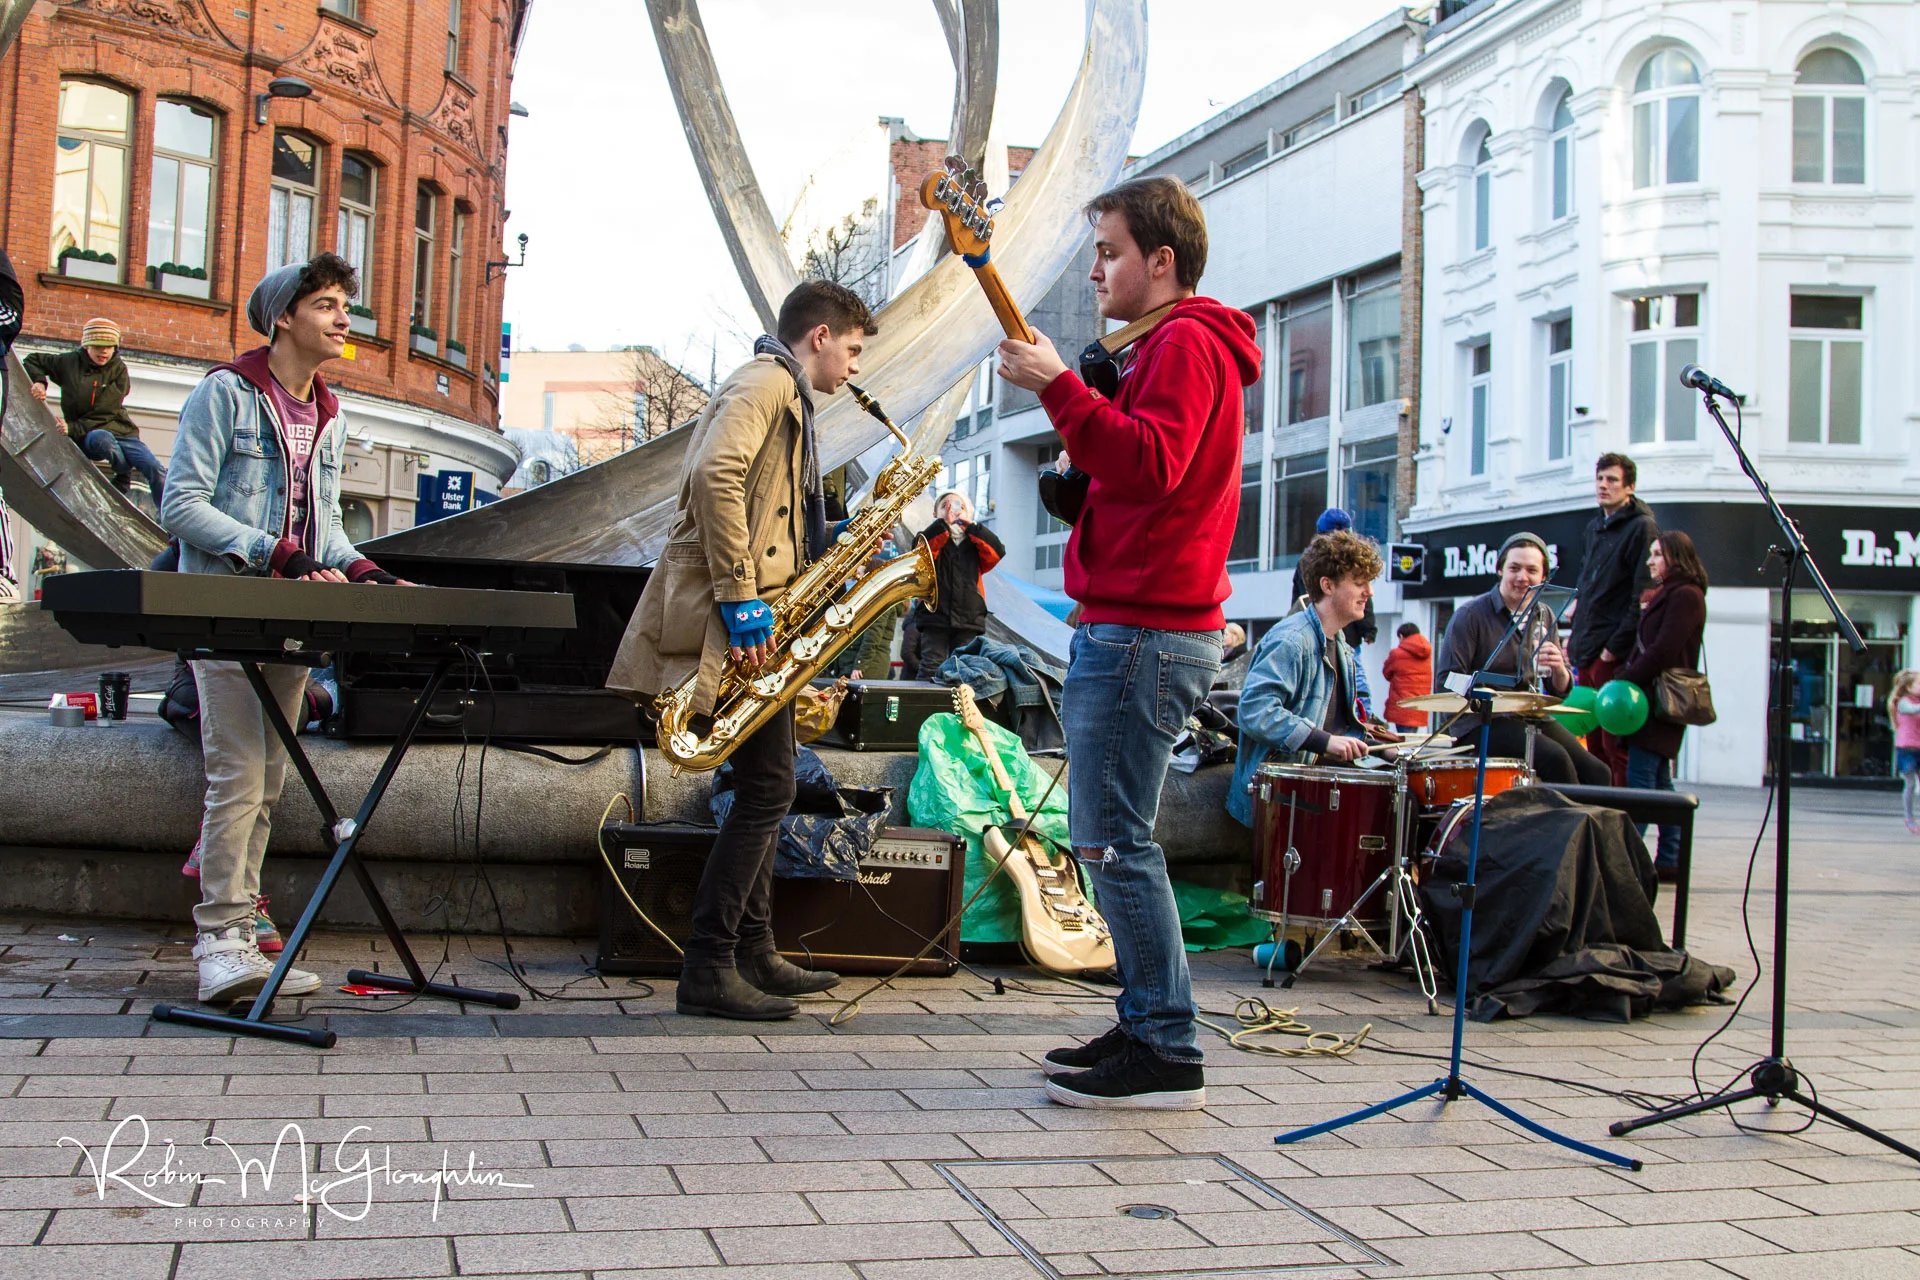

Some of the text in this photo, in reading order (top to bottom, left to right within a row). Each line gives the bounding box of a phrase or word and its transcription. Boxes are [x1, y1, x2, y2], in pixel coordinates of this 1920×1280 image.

[441, 492, 465, 501] Ulster
[442, 501, 462, 510] Bank
[624, 861, 650, 870] Roland
